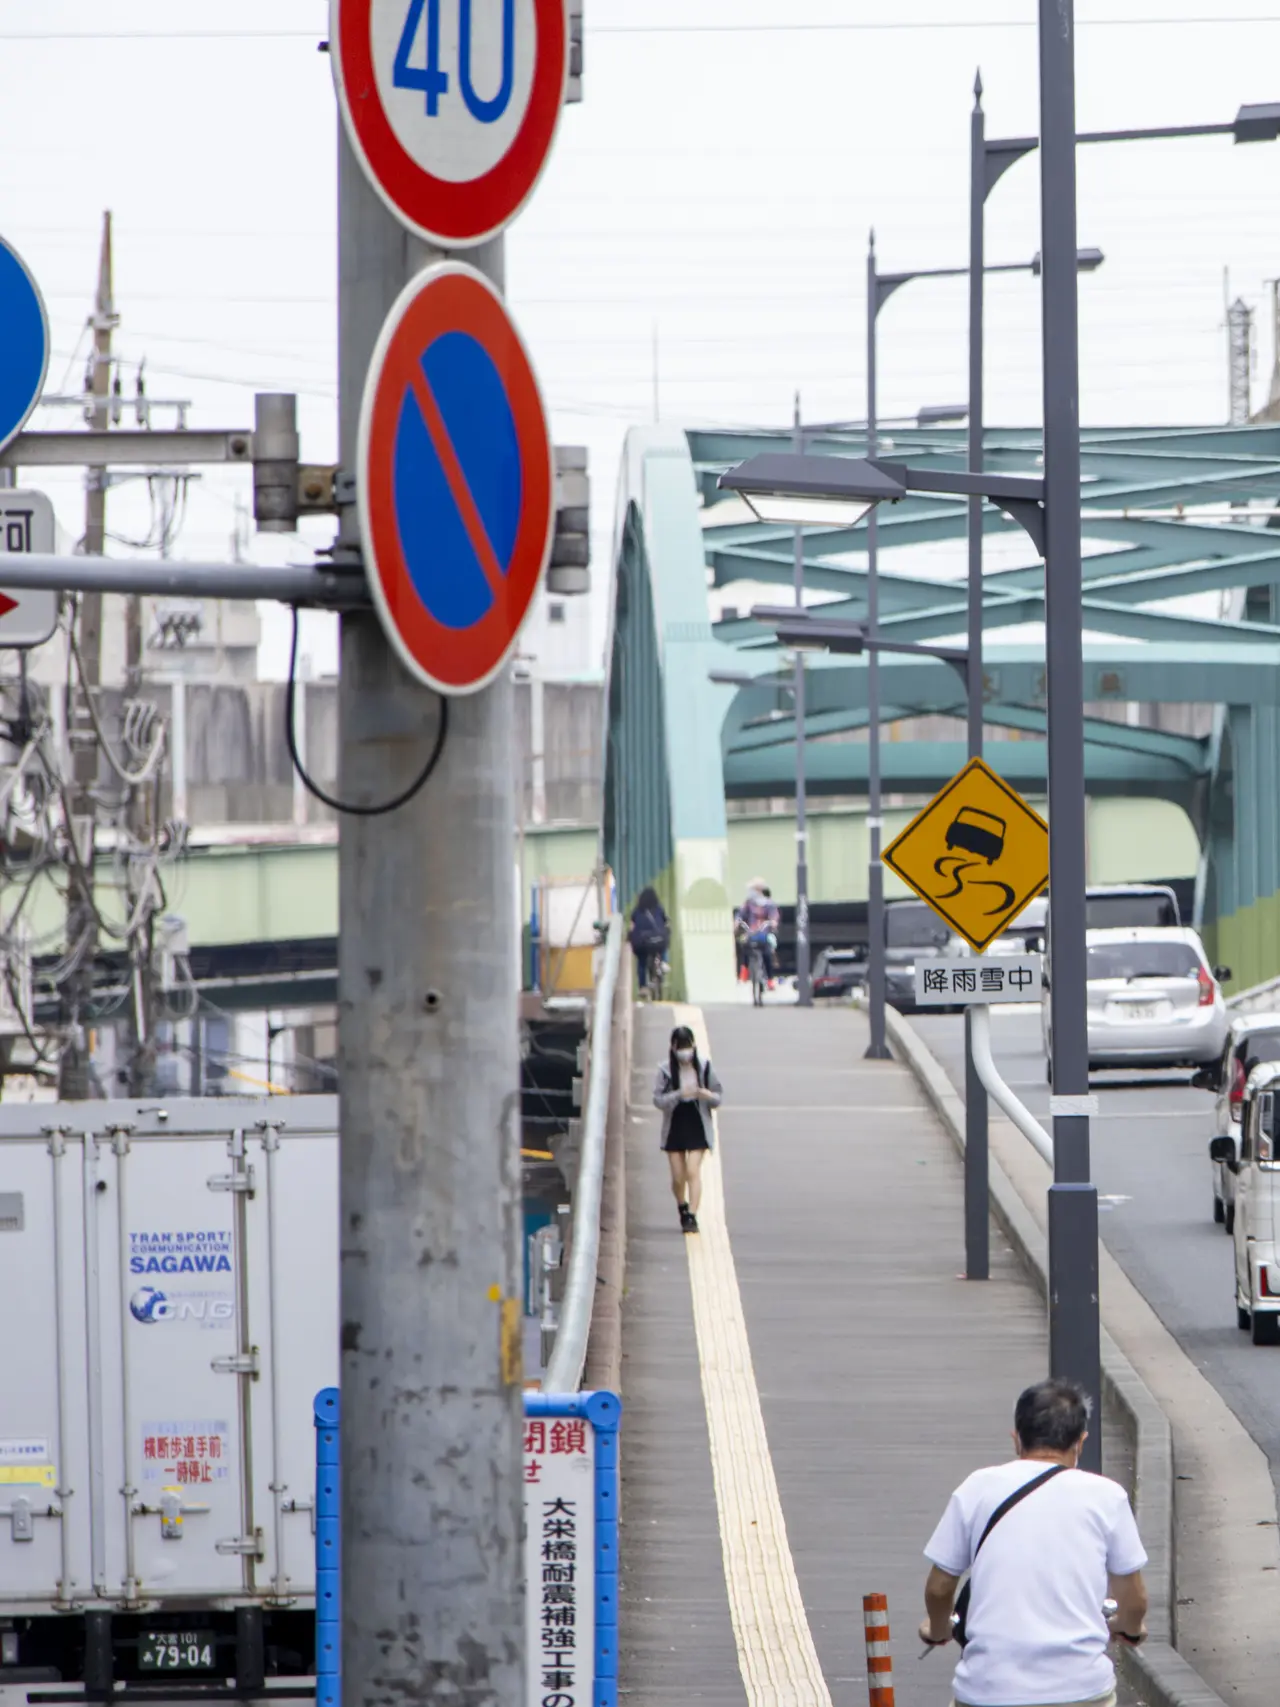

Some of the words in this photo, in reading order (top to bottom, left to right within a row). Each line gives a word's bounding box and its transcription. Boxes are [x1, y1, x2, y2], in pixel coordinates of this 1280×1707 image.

[393, 0, 515, 124] 40
[923, 965, 1033, 993] 降雨雪中
[131, 1243, 230, 1253] COMMUNICATION
[129, 1255, 232, 1273] SAGAWA
[152, 1300, 233, 1321] CNG
[144, 1435, 221, 1460] 横断歩道手前
[163, 1460, 213, 1484] 一時停止
[540, 1496, 577, 1707] 大栄橋耐震補強工事の
[180, 1632, 198, 1644] 101
[155, 1645, 212, 1667] 79-04
